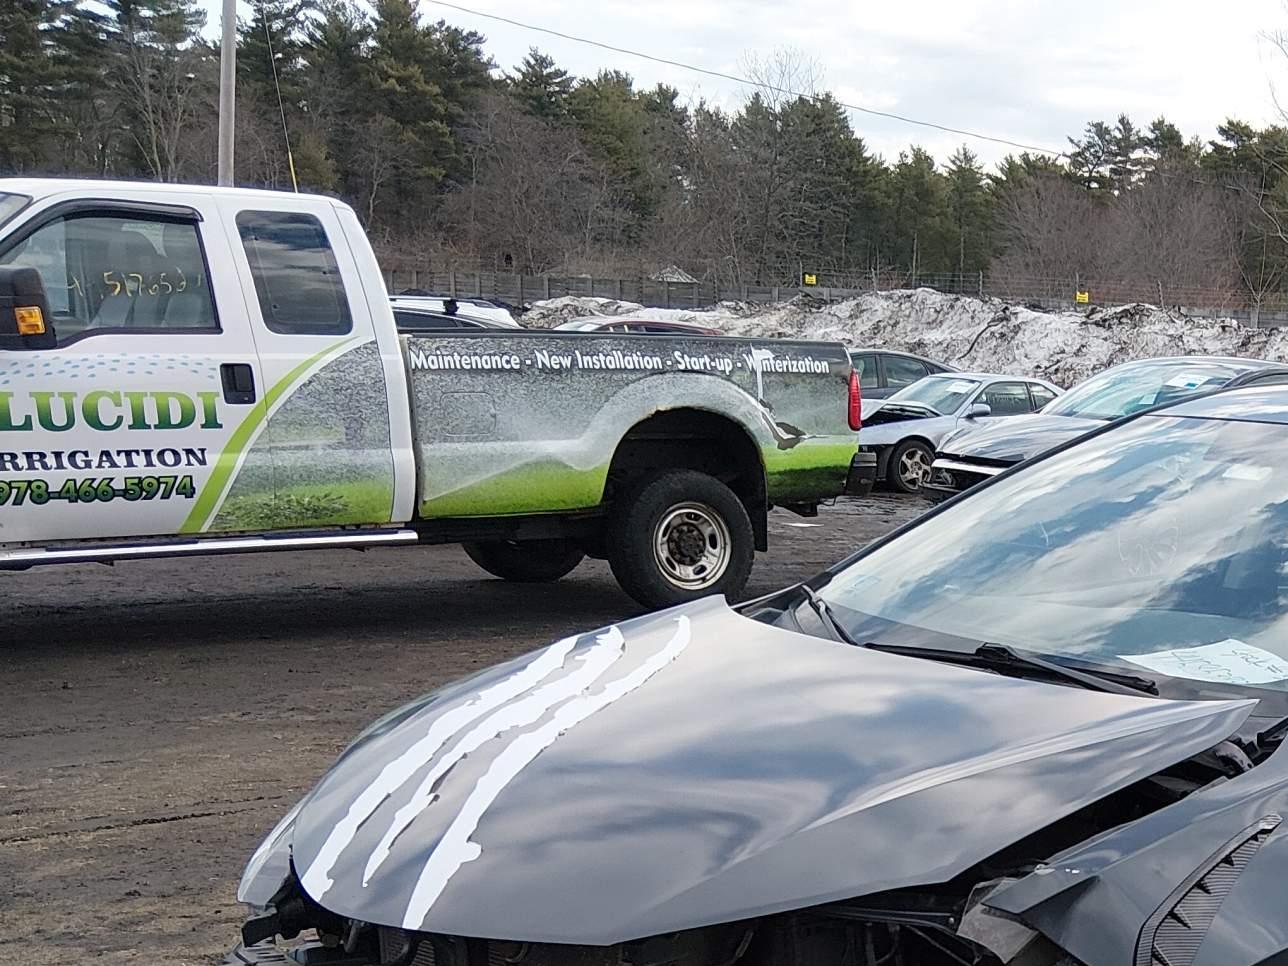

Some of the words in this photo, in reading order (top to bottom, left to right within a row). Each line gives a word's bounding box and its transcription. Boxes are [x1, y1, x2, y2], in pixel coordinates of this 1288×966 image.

[410, 350, 520, 370] Maintenance
[535, 349, 572, 369] New
[575, 349, 662, 369] Installation
[673, 351, 733, 375] Start-up
[742, 353, 830, 374] Wnterization
[0, 390, 223, 432] LUCIDI
